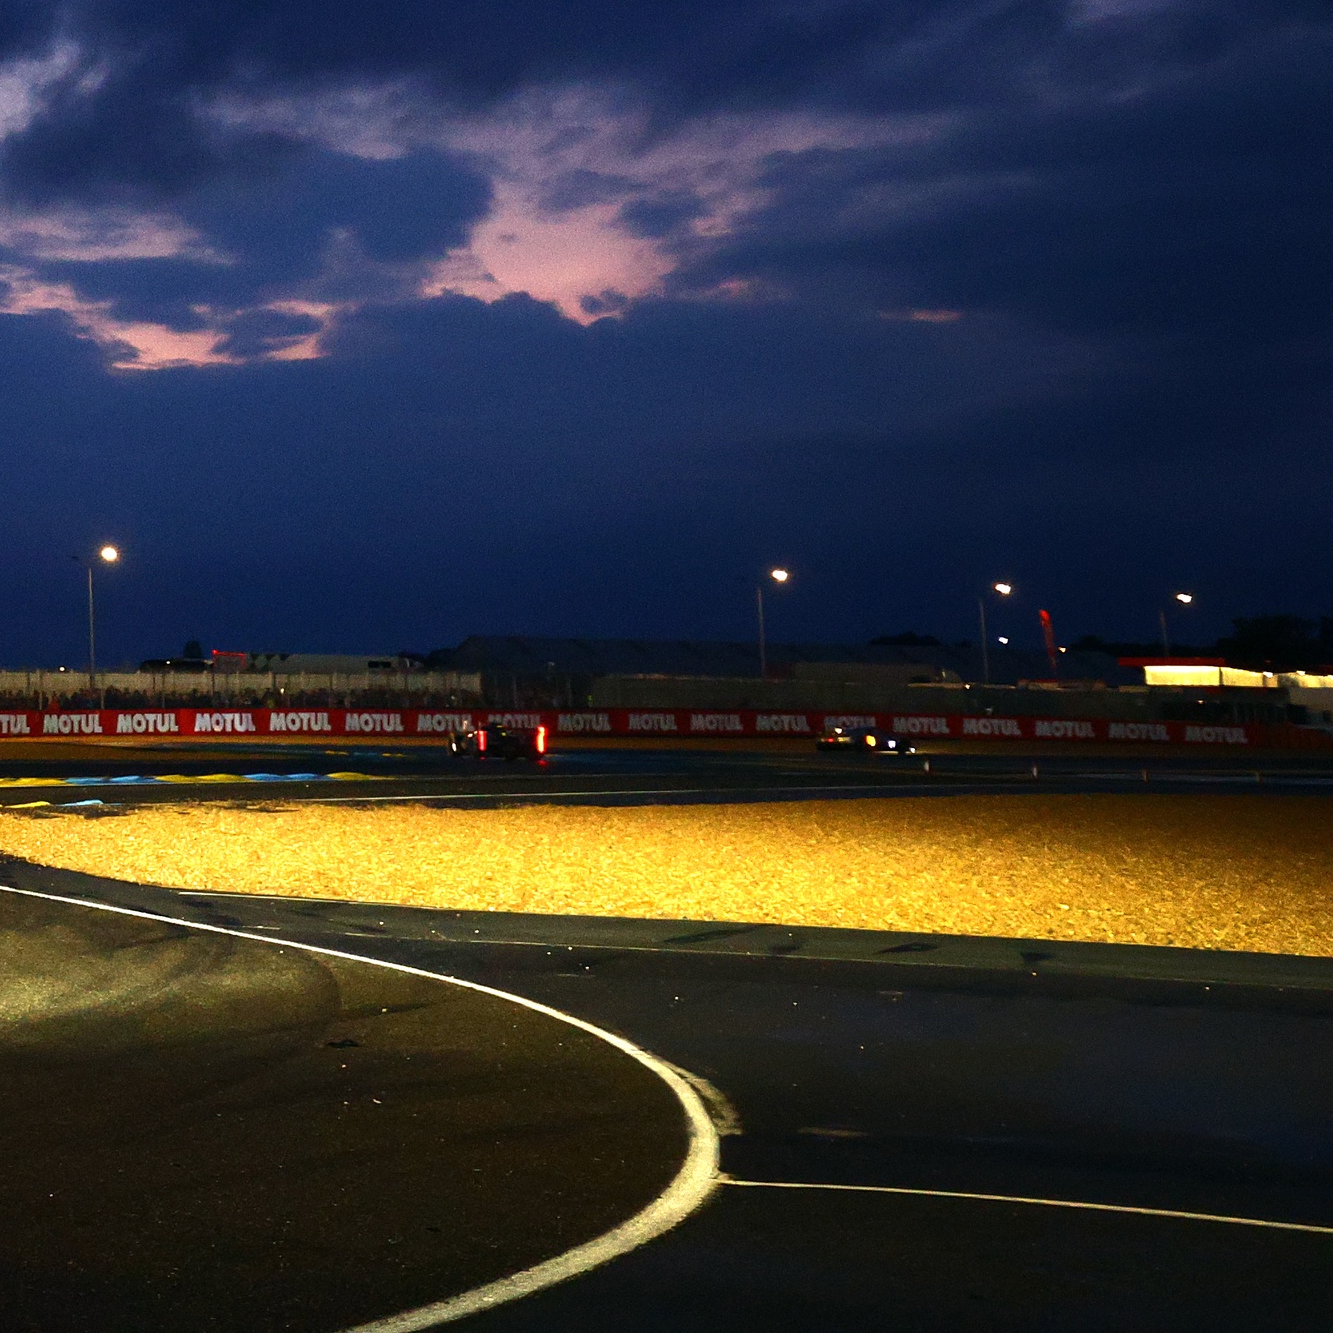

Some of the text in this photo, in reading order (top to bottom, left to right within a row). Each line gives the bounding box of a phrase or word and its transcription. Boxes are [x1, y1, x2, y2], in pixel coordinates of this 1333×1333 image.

[44, 714, 104, 734] MOTUL
[116, 713, 179, 734] MOTUL
[194, 713, 257, 733] MOTUL
[269, 712, 332, 732] MOTUL
[345, 713, 405, 733] MOTUL
[418, 713, 477, 733] MOTUL
[558, 713, 612, 732] MOTUL
[630, 713, 679, 731] MOTUL
[692, 713, 745, 731] MOTUL
[757, 714, 811, 732] MOTUL
[893, 716, 950, 734] MOTUL
[963, 718, 1022, 736] MOTUL
[1036, 720, 1096, 738] MOTUL
[1108, 722, 1171, 741] MOTUL
[1185, 726, 1249, 744] MOTUL
